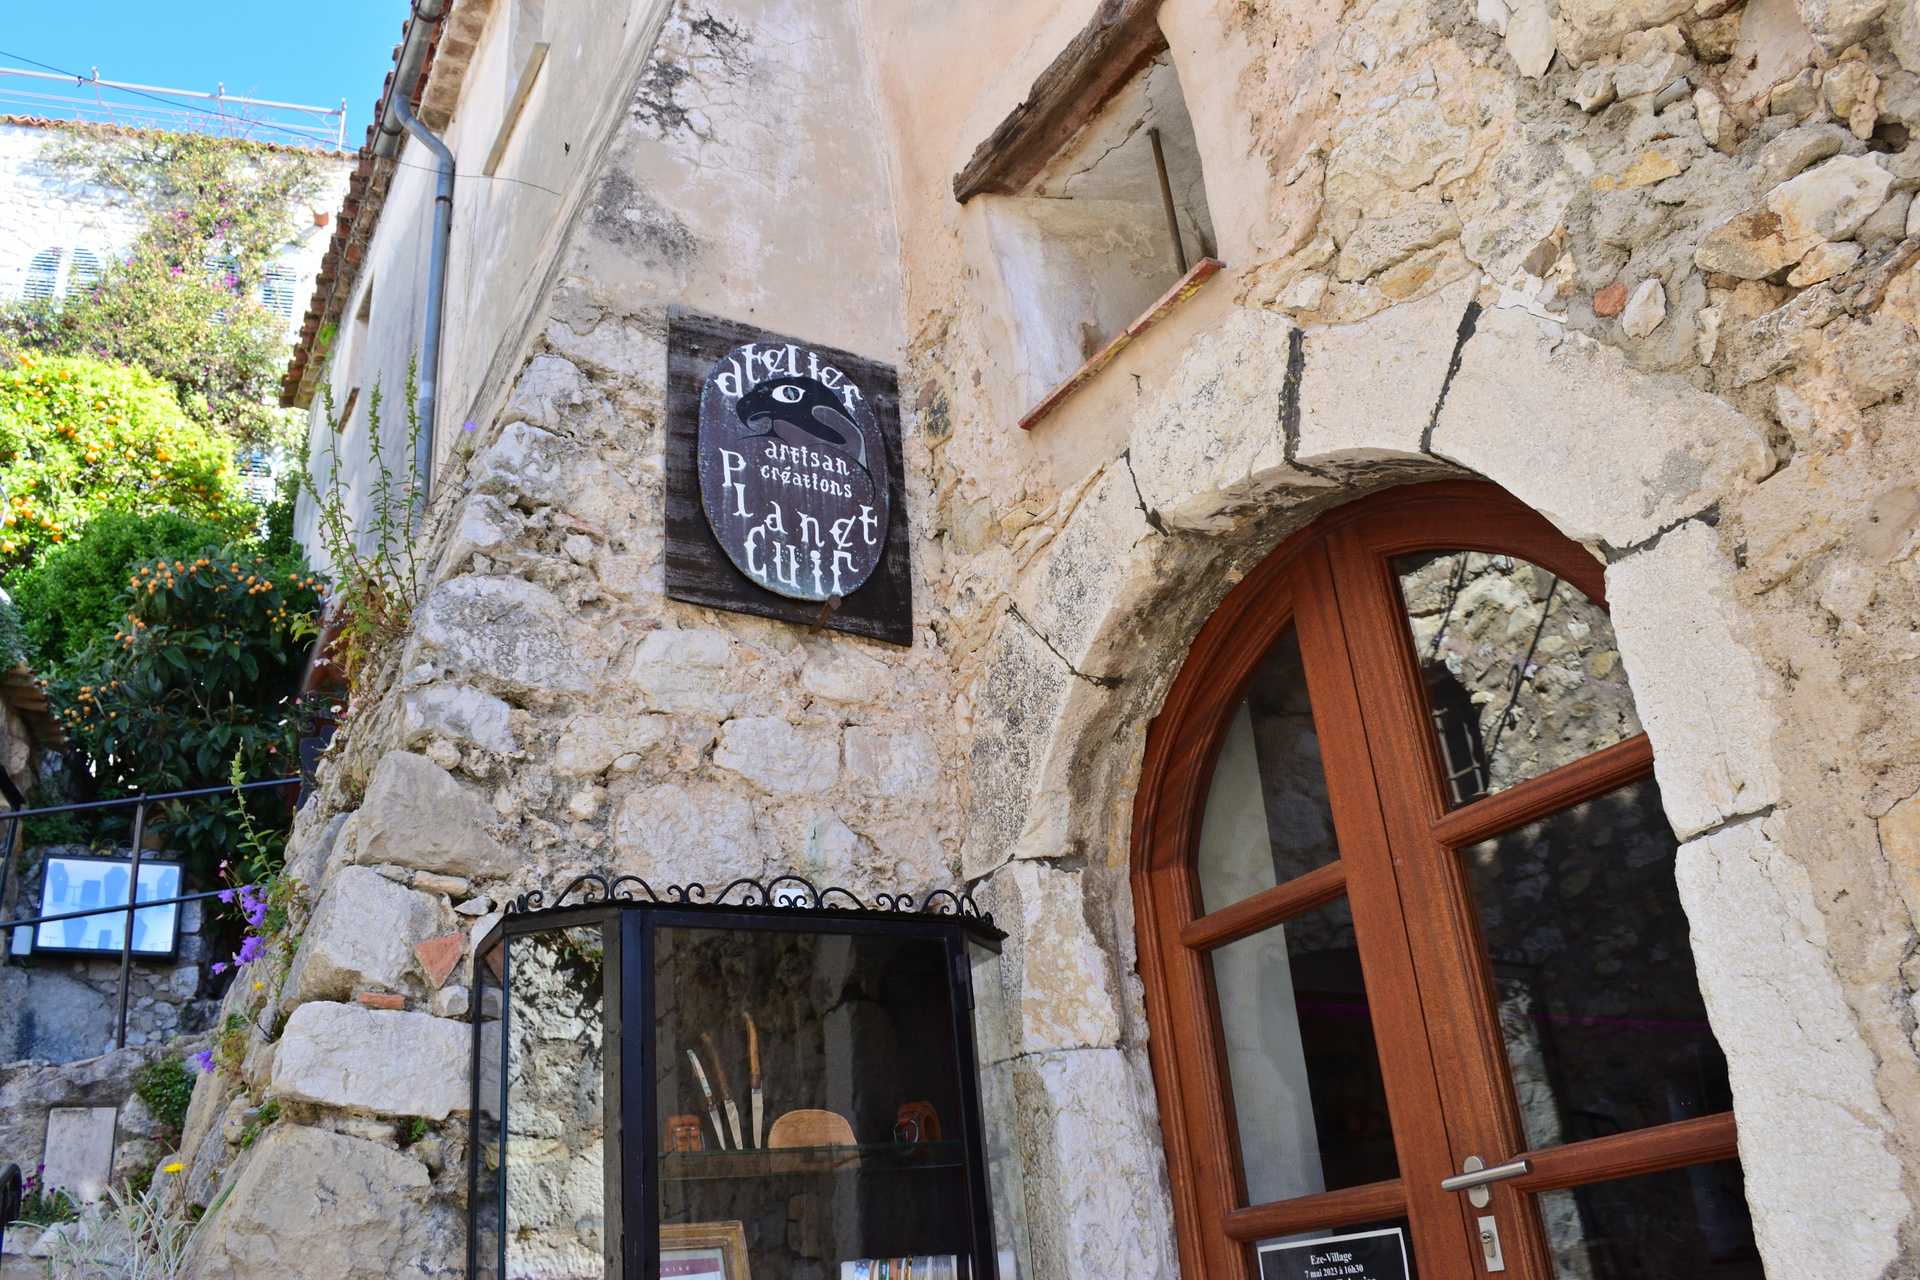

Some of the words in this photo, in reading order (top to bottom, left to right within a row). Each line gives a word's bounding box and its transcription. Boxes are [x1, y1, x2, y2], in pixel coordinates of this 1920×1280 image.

[765, 441, 850, 476] artisan
[760, 464, 852, 498] créations
[1310, 1252, 1352, 1265] Eze-Village
[1310, 1268, 1322, 1278] mai
[1323, 1267, 1338, 1277] 2023
[1345, 1264, 1364, 1275] 16h30
